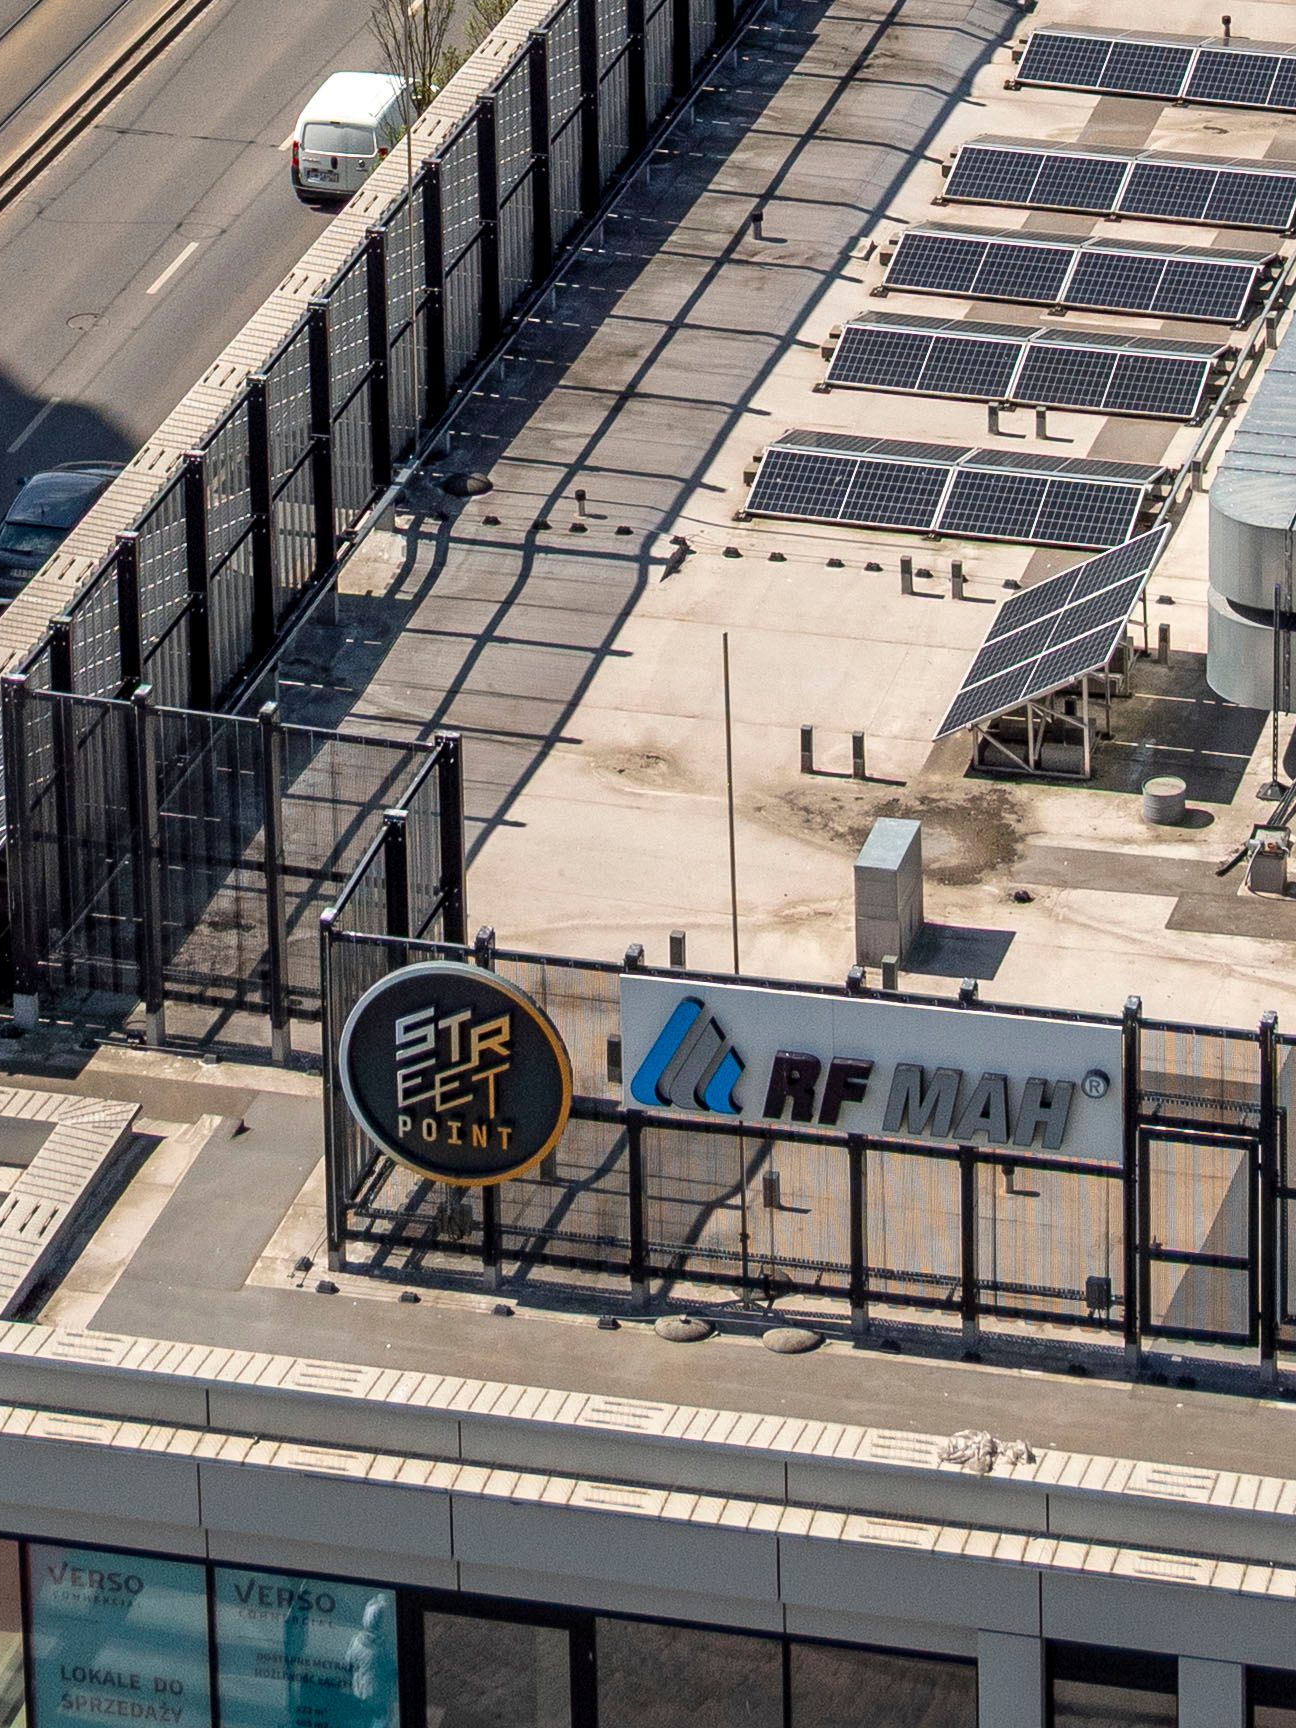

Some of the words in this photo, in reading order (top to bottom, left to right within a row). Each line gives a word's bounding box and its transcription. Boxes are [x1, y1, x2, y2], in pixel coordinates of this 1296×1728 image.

[762, 1050, 875, 1127] RF
[882, 1061, 1077, 1151] MAH
[397, 1115, 513, 1151] POINT
[49, 1563, 145, 1595] VERSO
[233, 1580, 337, 1614] VERSO
[60, 1665, 142, 1691] LOKALE
[154, 1676, 184, 1696] DO
[61, 1692, 183, 1725] SPRZEDAŻY
